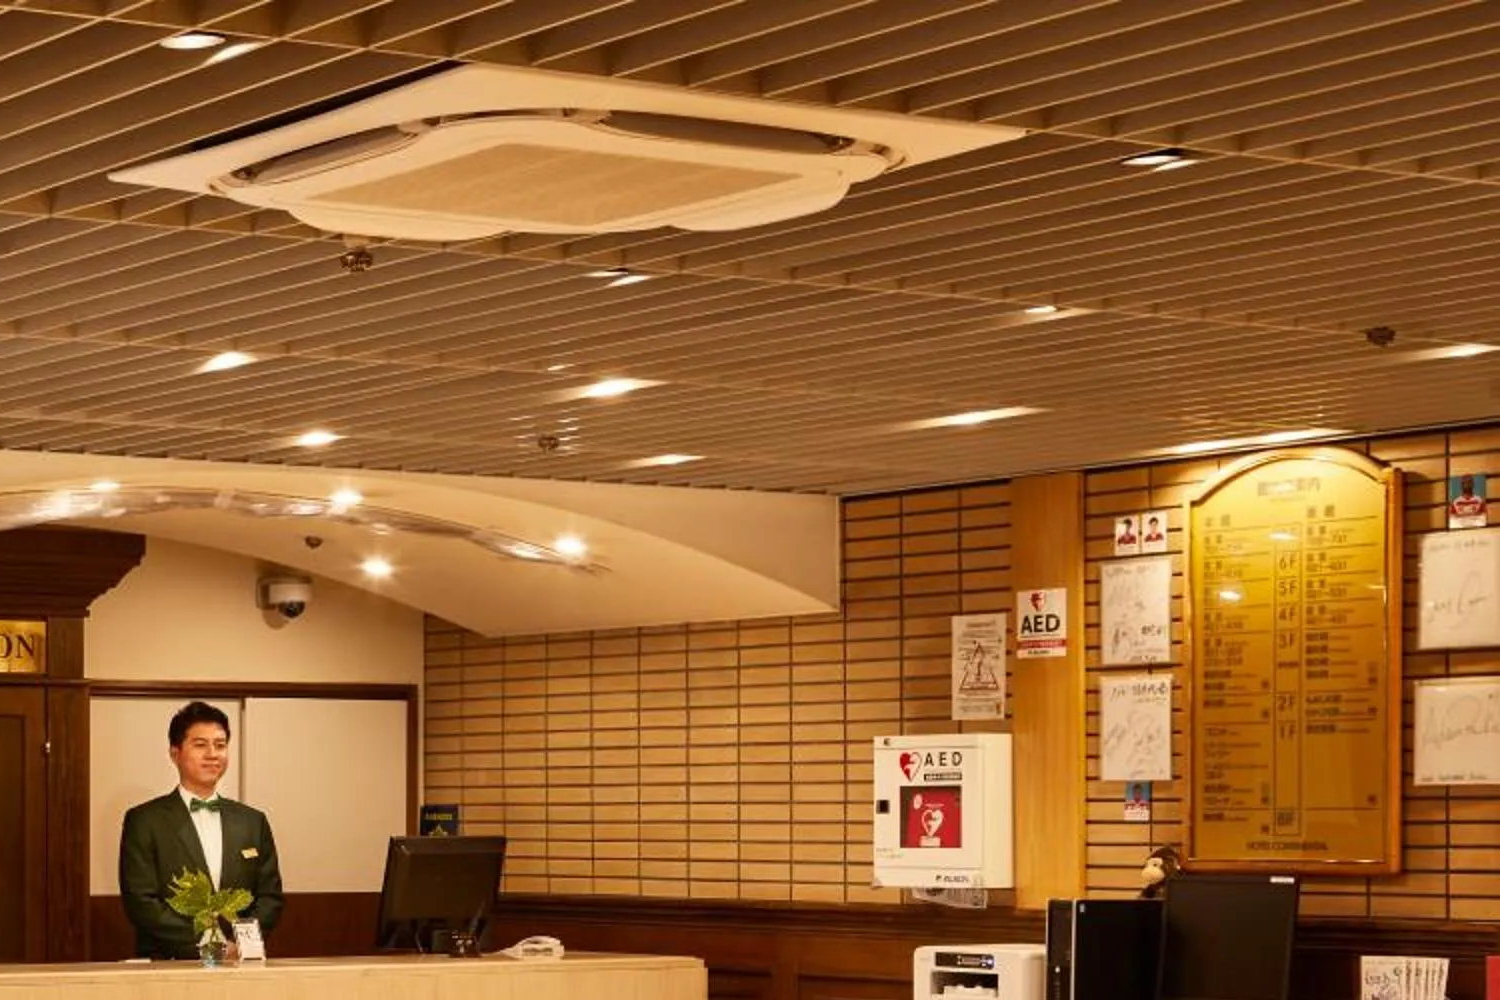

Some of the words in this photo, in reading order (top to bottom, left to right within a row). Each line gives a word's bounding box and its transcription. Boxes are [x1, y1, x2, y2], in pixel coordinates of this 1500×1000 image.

[1278, 556, 1297, 571] 6F
[1278, 579, 1298, 597] 5F
[1020, 613, 1061, 635] AED
[923, 751, 963, 767] AED
